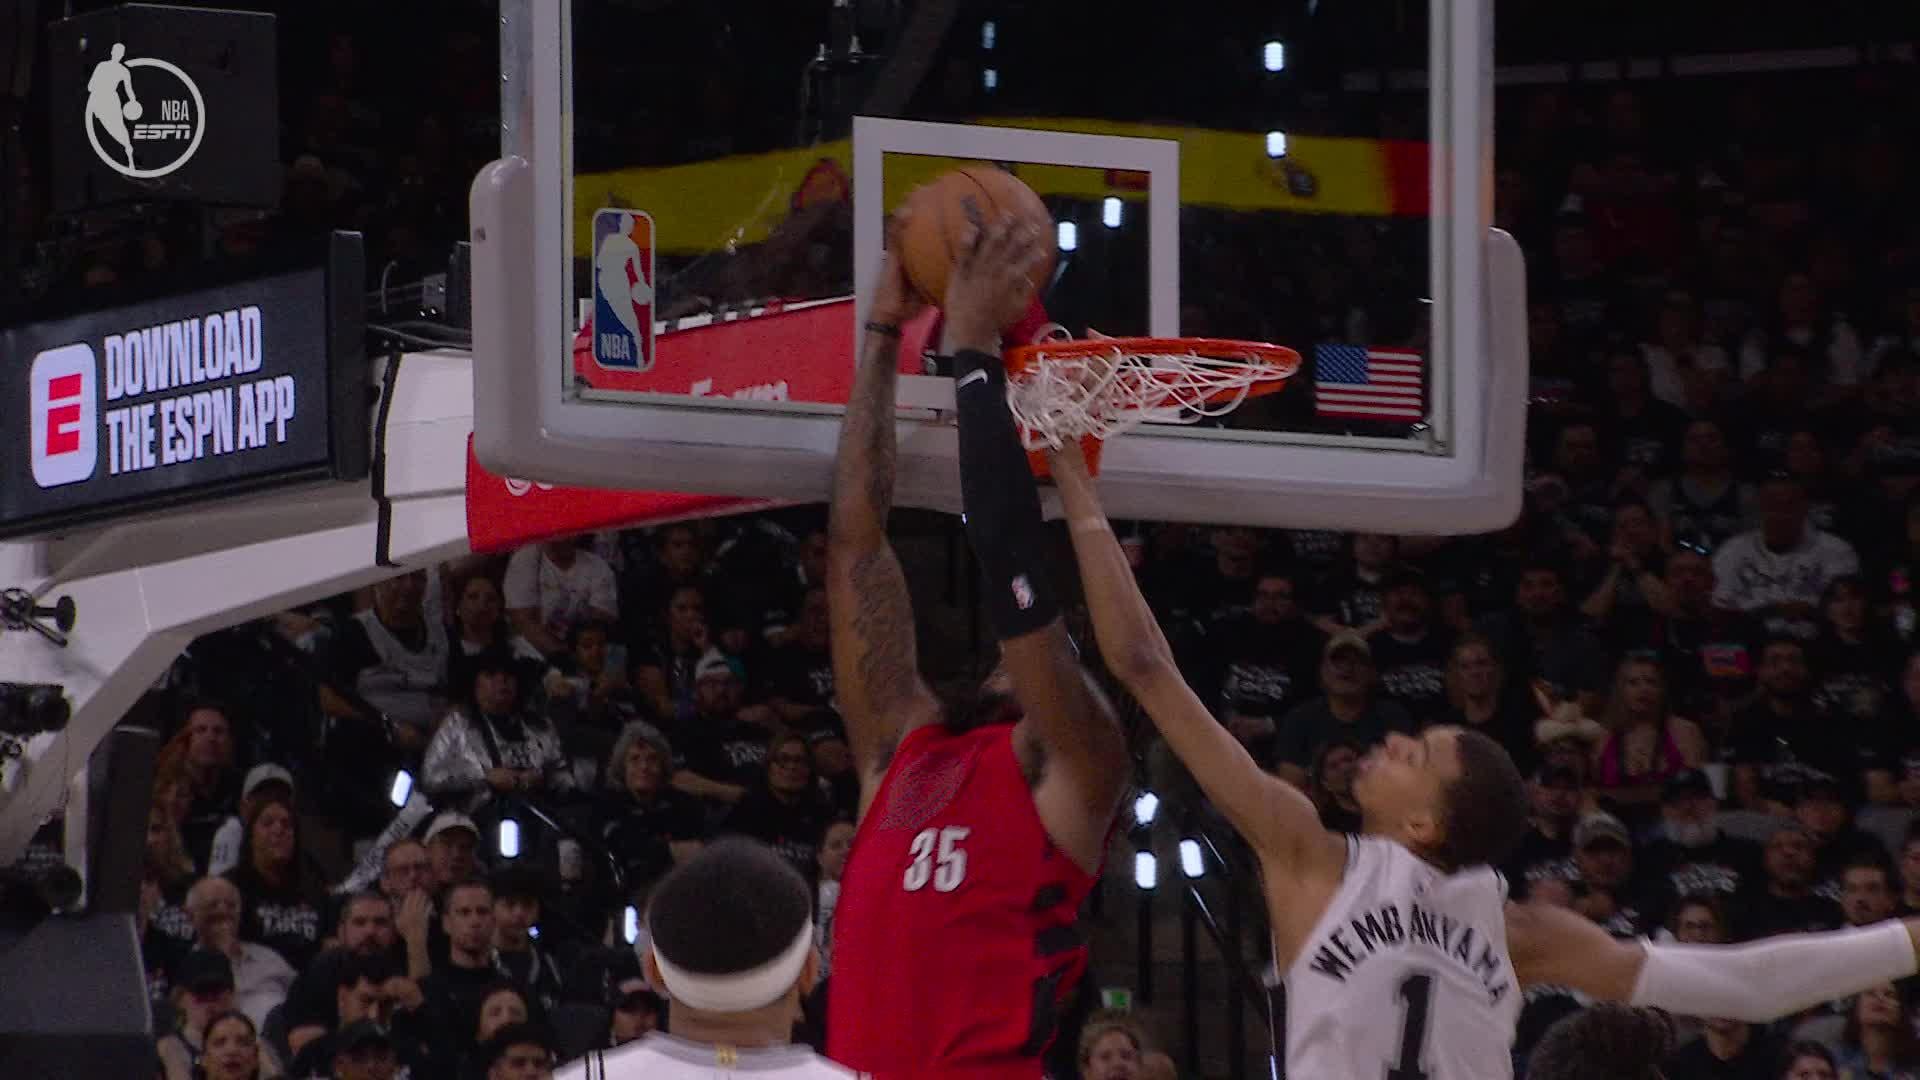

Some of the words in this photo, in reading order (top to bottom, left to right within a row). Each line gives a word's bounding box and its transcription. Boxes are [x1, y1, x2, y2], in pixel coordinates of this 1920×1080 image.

[104, 306, 262, 400] DOWNLOAD
[601, 333, 630, 359] NBA
[106, 406, 156, 474] THE
[160, 387, 233, 464] ESPN
[238, 375, 295, 450] APP
[903, 825, 971, 892] 35
[1387, 970, 1434, 1080] 1
